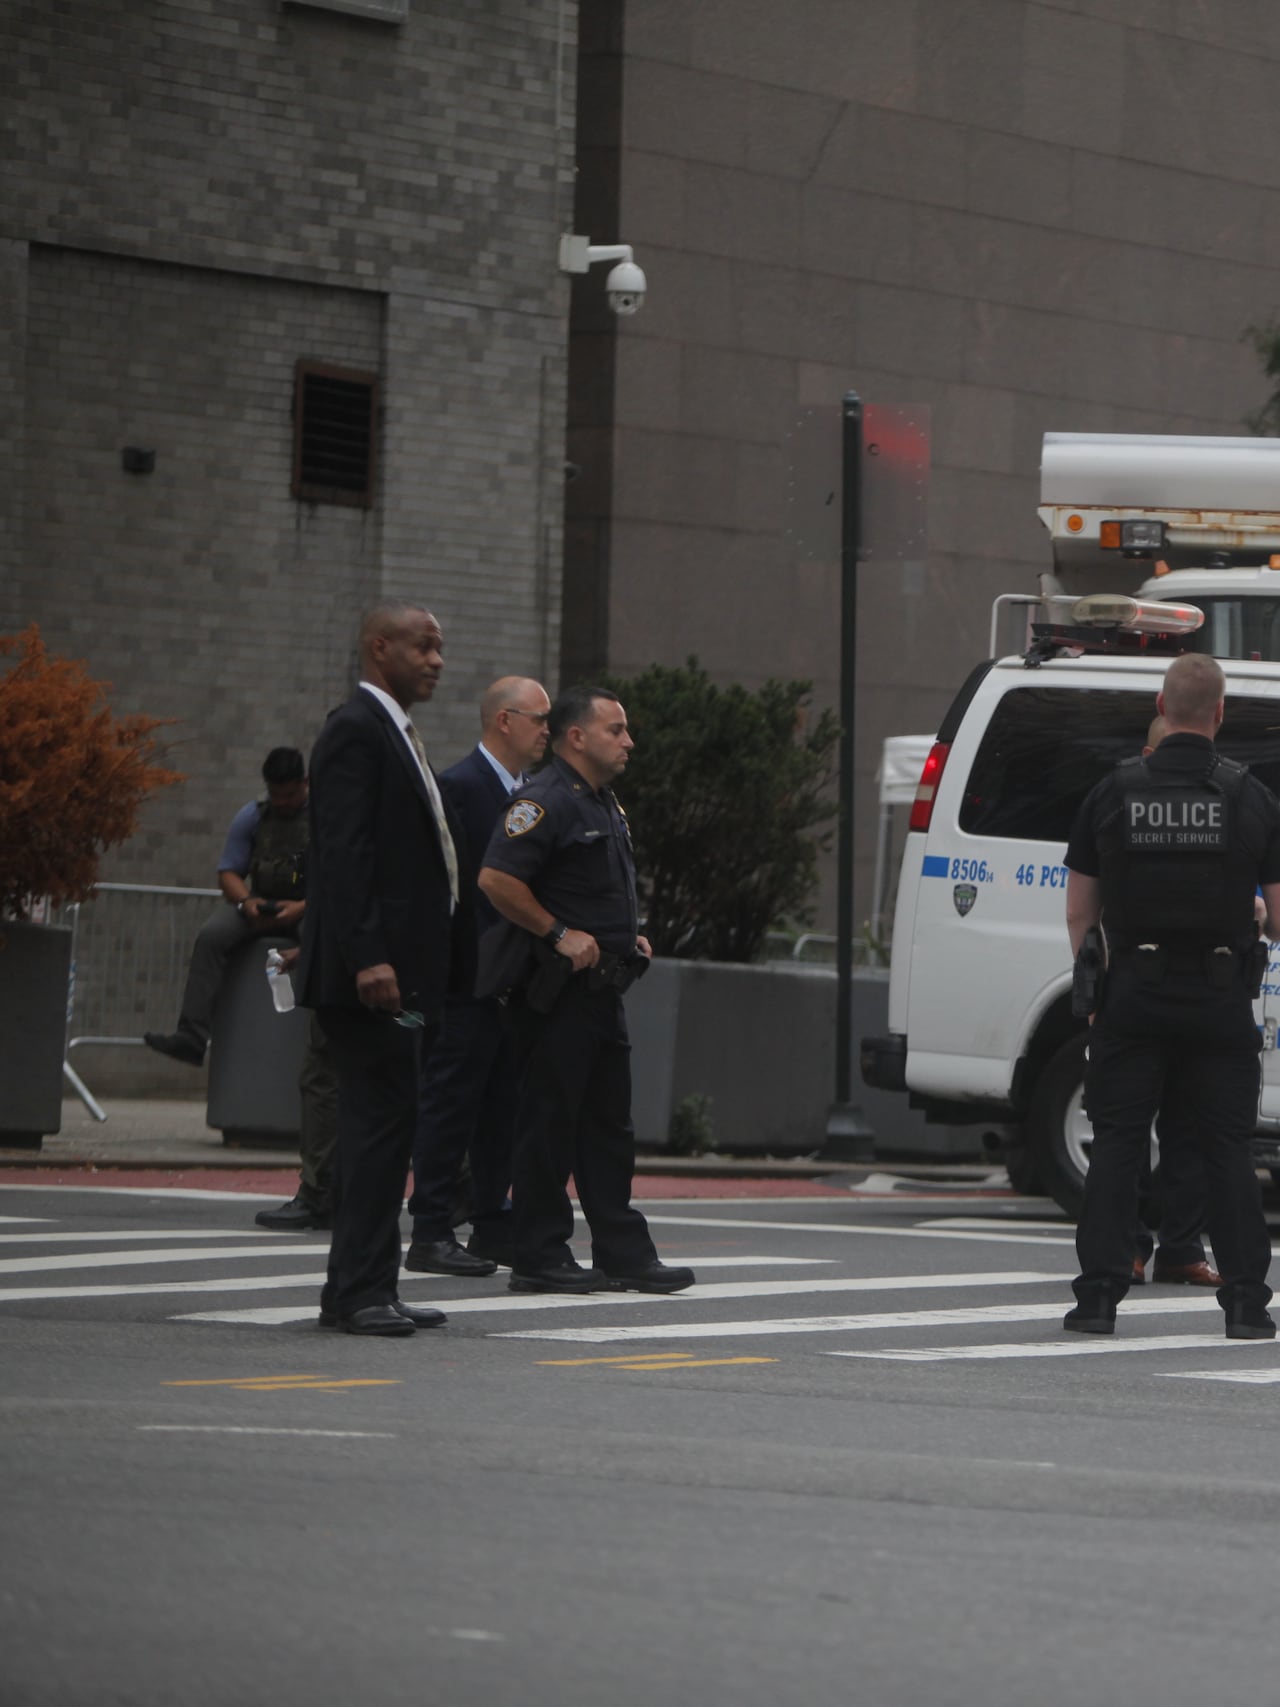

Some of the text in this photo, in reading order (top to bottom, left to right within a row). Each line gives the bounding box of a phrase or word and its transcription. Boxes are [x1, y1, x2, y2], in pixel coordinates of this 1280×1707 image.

[1131, 802, 1222, 827] POLICE
[1131, 832, 1221, 845] SECRET SERVICE
[951, 858, 987, 882] 8506
[1016, 864, 1070, 888] 46 PCT
